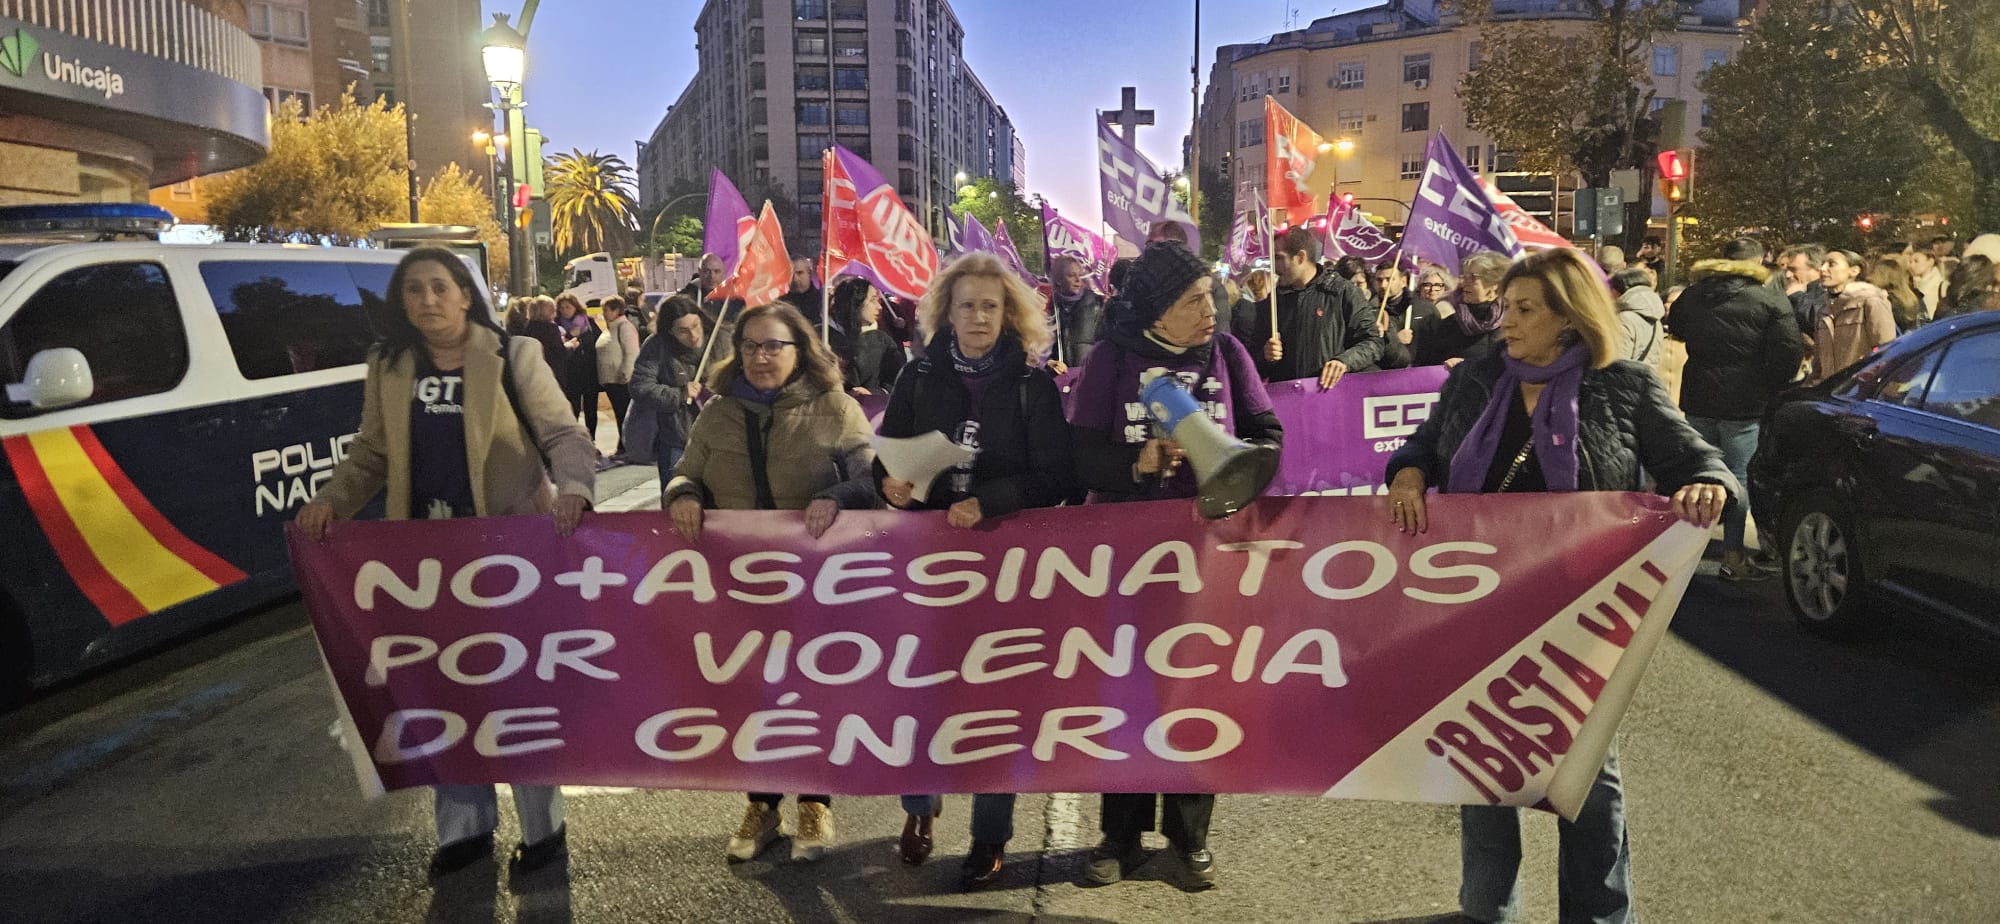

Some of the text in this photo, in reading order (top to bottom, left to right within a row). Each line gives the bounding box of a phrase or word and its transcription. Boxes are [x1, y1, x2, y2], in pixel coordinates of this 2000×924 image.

[43, 51, 124, 98] Unicaja
[1424, 217, 1489, 253] extrem
[413, 375, 463, 403] GT
[424, 402, 464, 415] Femin
[252, 431, 361, 485] POLIC
[1374, 437, 1407, 453] extr
[364, 623, 1349, 689] POR VIOLENCIA
[375, 691, 1245, 767] DE GÉNERO
